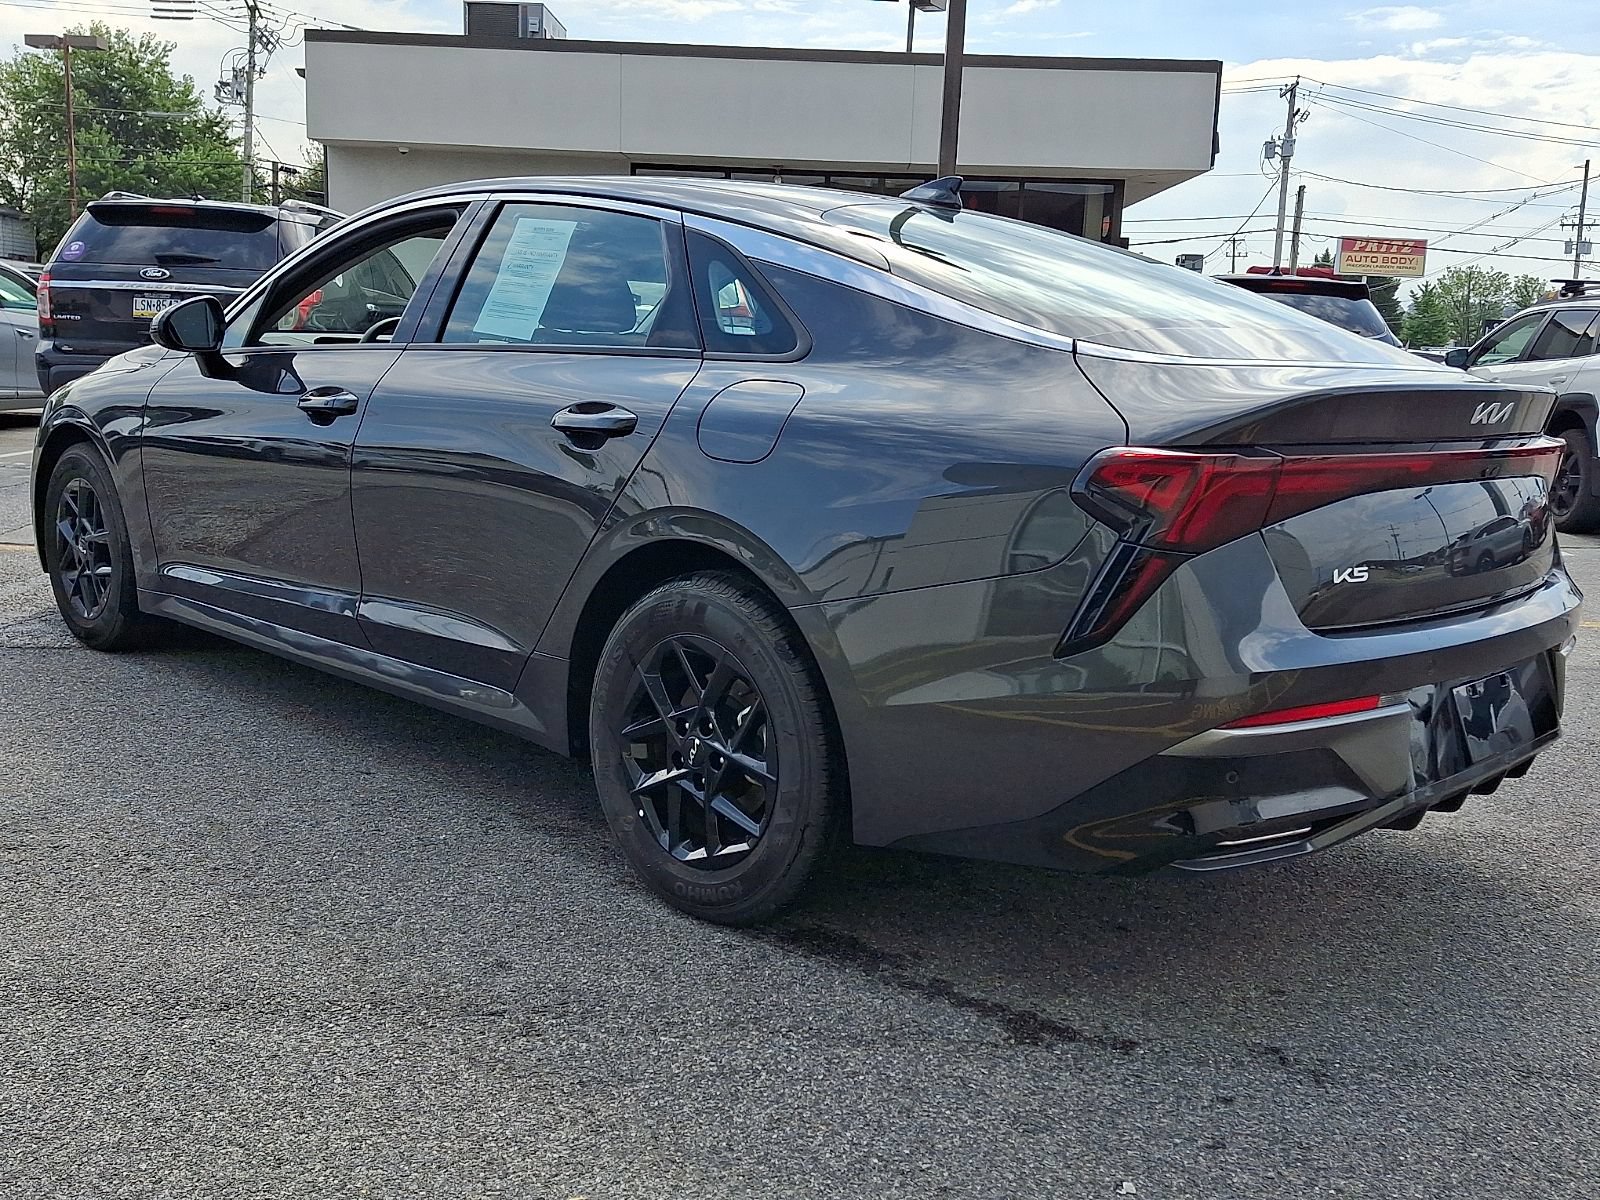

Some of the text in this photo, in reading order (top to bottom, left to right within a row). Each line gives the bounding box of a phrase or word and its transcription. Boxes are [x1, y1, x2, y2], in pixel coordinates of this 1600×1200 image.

[1353, 240, 1415, 253] PRITZ
[1345, 254, 1379, 264] AUTO
[1382, 255, 1416, 265] BODY
[145, 269, 162, 277] Ford
[1333, 566, 1369, 583] K5
[674, 880, 742, 902] KUMHO
